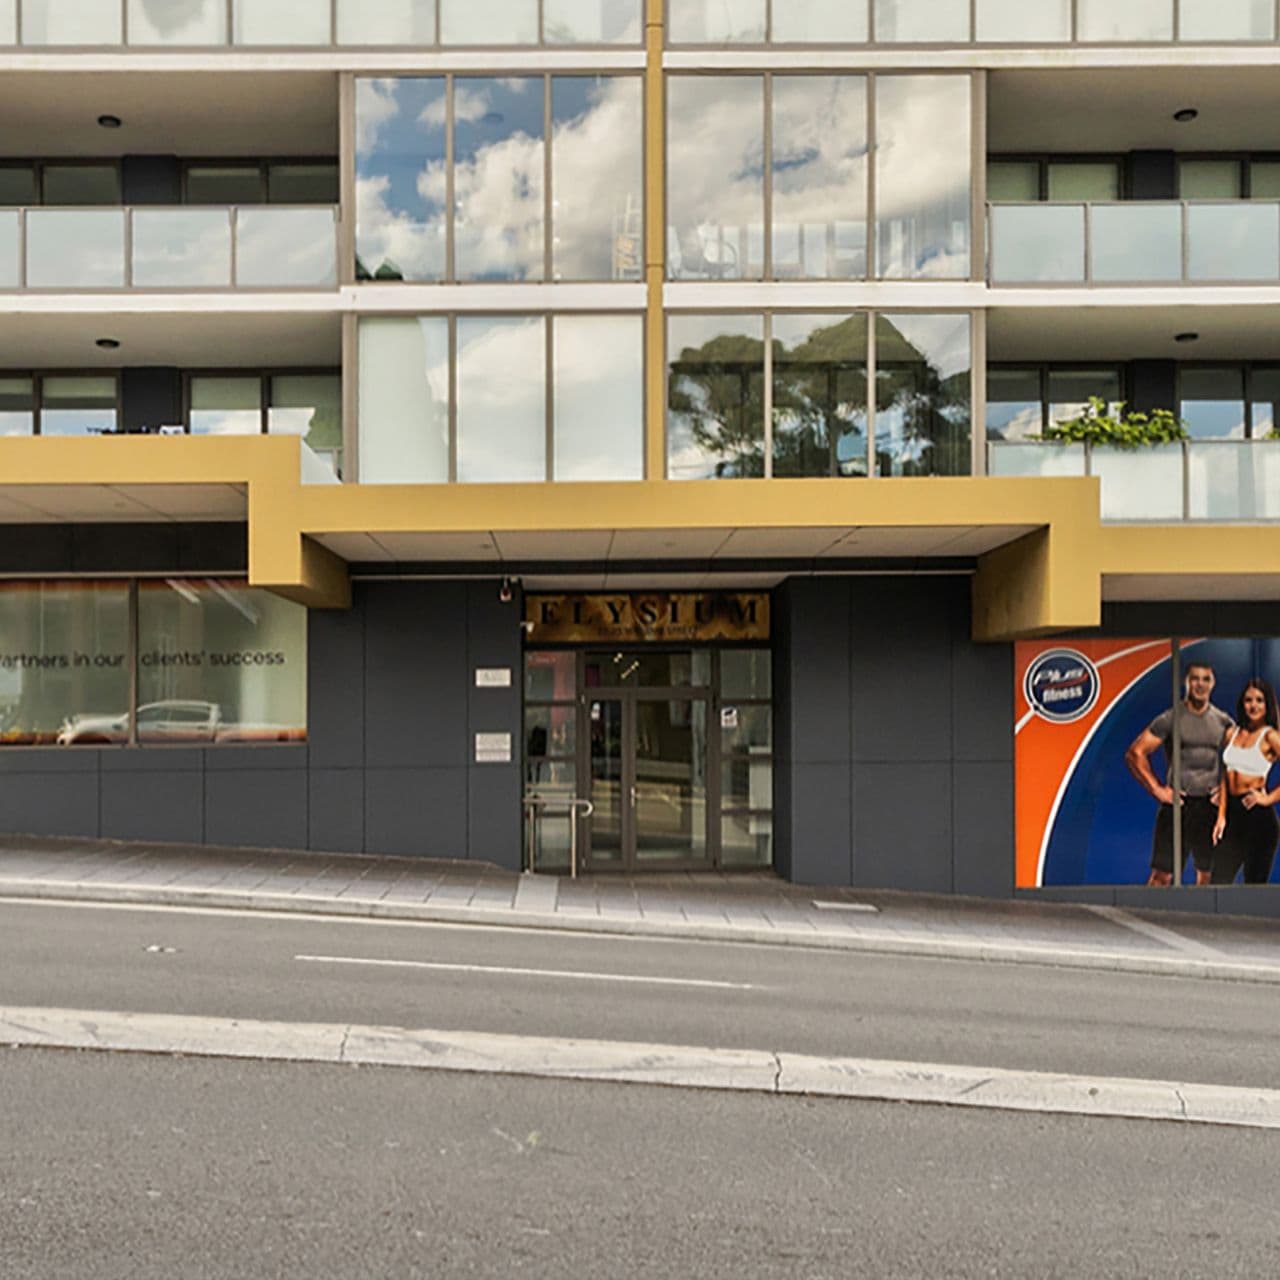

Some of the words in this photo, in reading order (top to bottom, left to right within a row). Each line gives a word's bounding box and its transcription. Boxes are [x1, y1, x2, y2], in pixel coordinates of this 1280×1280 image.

[539, 600, 758, 625] ELYSIUM
[73, 651, 89, 666] in
[93, 653, 126, 666] our
[209, 652, 286, 665] success
